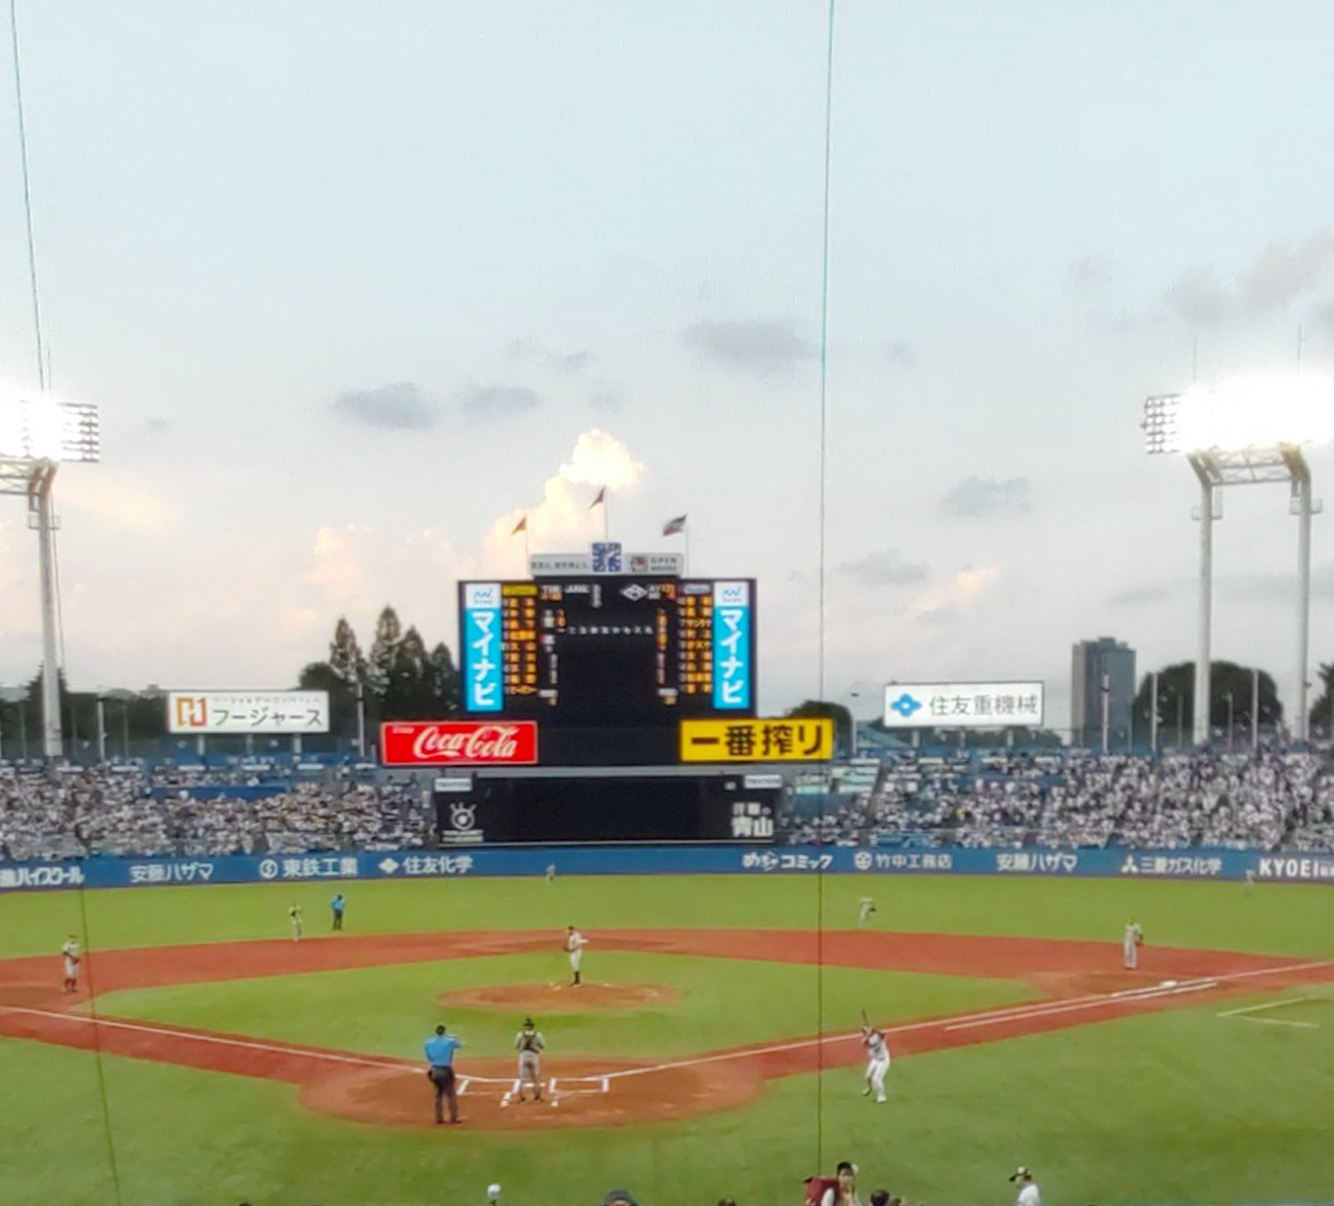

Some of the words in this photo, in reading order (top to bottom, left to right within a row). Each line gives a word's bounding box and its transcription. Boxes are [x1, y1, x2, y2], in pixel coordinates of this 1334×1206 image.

[471, 611, 497, 705] マイナビ
[720, 609, 744, 703] マイナビ
[930, 694, 1038, 716] 住友重機械
[212, 707, 323, 727] フージャース
[691, 725, 822, 756] 一番搾り
[731, 816, 773, 837] 青山
[283, 858, 358, 877] 東鉄工業
[402, 857, 473, 875] 住友化学
[876, 853, 953, 870] 竹中工務店
[996, 853, 1078, 872] 安藤ハザマ
[1140, 857, 1222, 876] 三菱ガス化学
[1259, 858, 1318, 878] KYOEI
[129, 863, 214, 884] 安藤ハザマ
